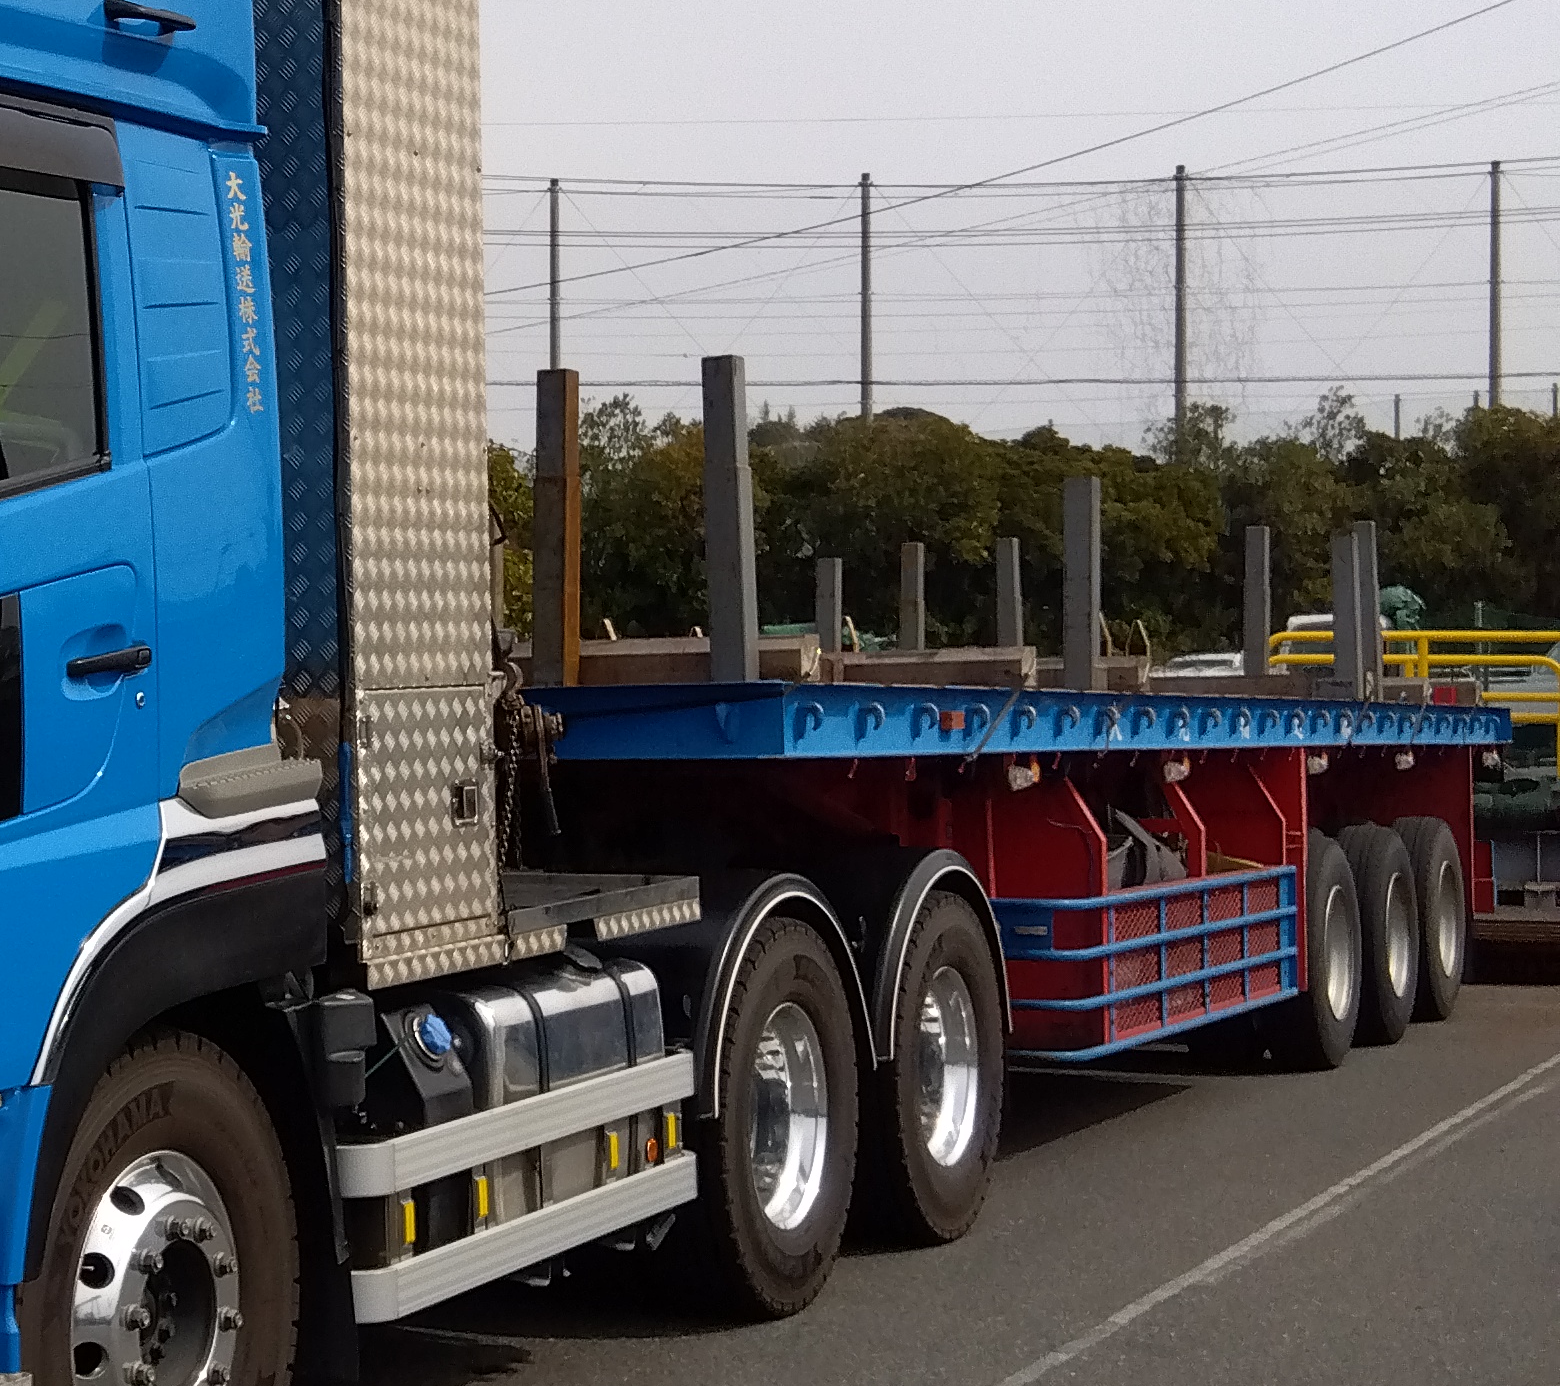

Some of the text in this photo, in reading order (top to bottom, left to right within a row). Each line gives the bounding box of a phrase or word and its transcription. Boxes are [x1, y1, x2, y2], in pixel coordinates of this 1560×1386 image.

[226, 171, 263, 414] 大光輸送株式会社
